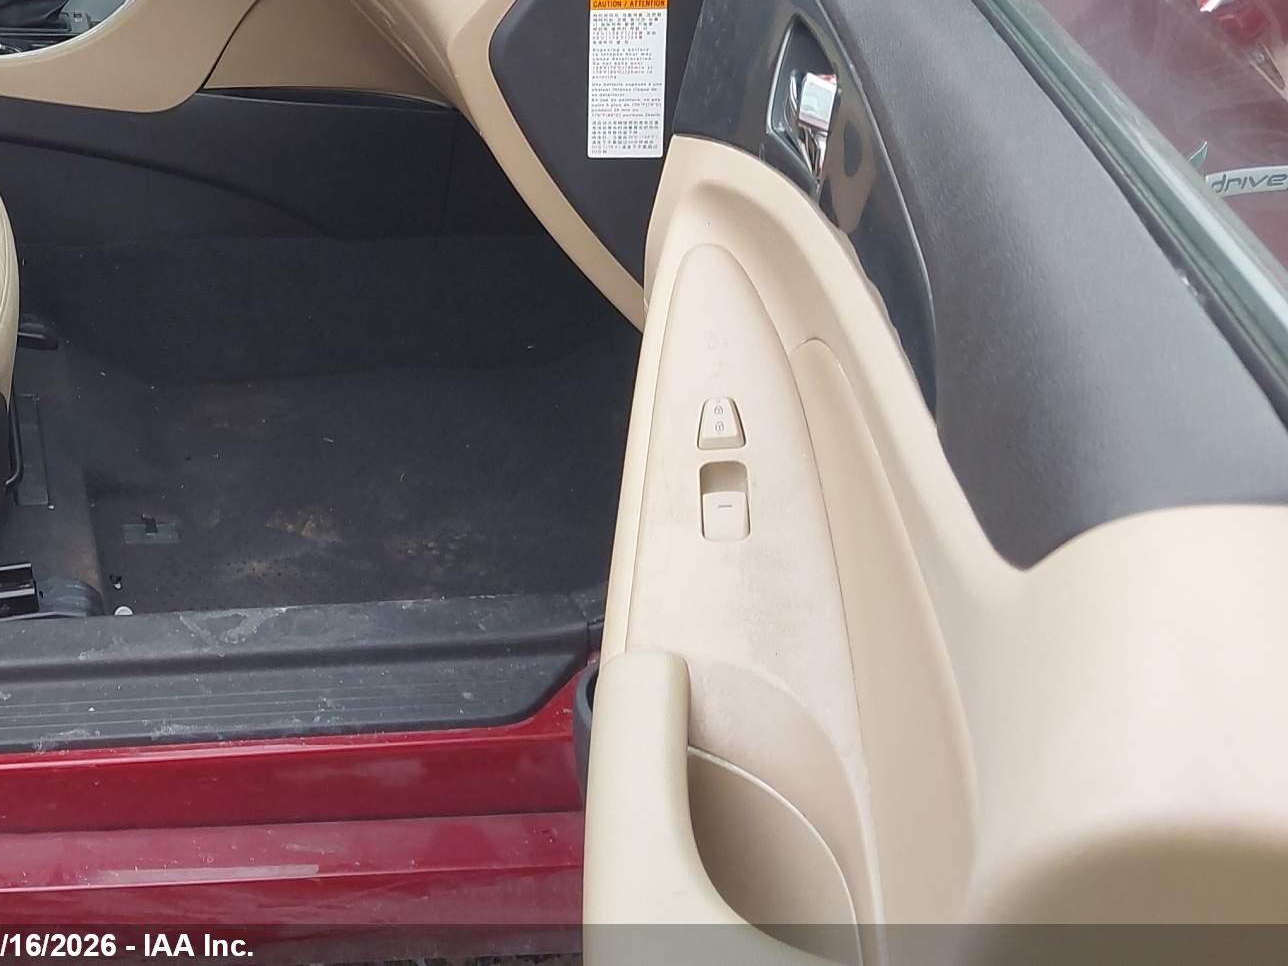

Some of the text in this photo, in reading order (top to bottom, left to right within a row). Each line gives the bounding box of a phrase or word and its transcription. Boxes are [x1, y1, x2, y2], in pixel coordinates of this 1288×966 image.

[593, 0, 621, 8] CAUTION
[629, 0, 665, 7] ATTENTION
[1211, 173, 1288, 194] drive
